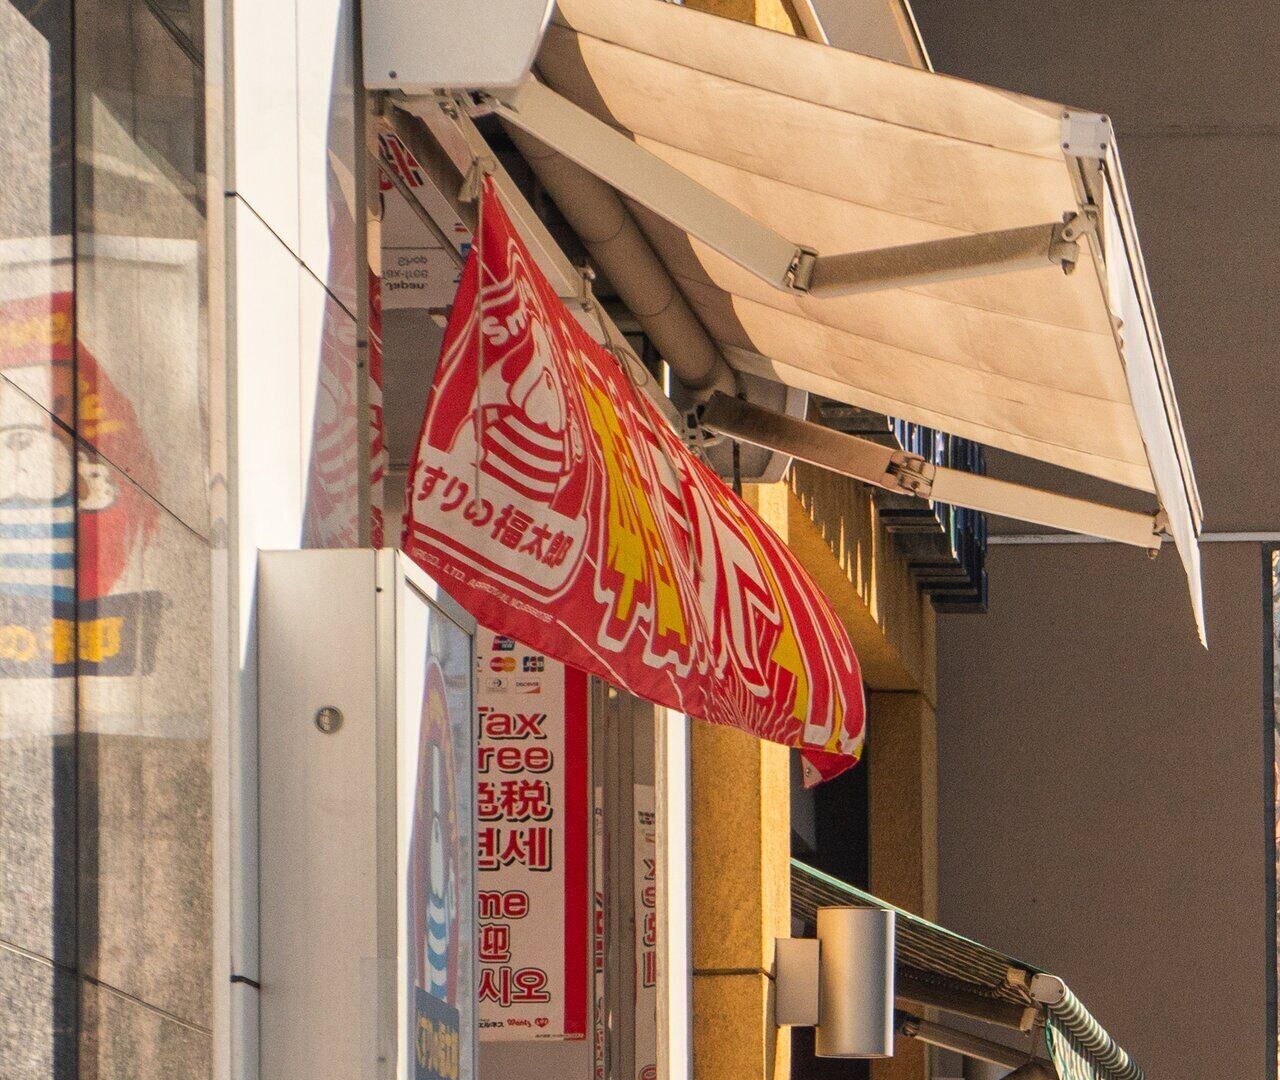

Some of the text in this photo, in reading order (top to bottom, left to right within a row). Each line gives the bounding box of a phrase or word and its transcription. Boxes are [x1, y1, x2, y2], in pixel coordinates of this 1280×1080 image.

[416, 460, 574, 568] すりの福太郎
[478, 745, 551, 773] ree
